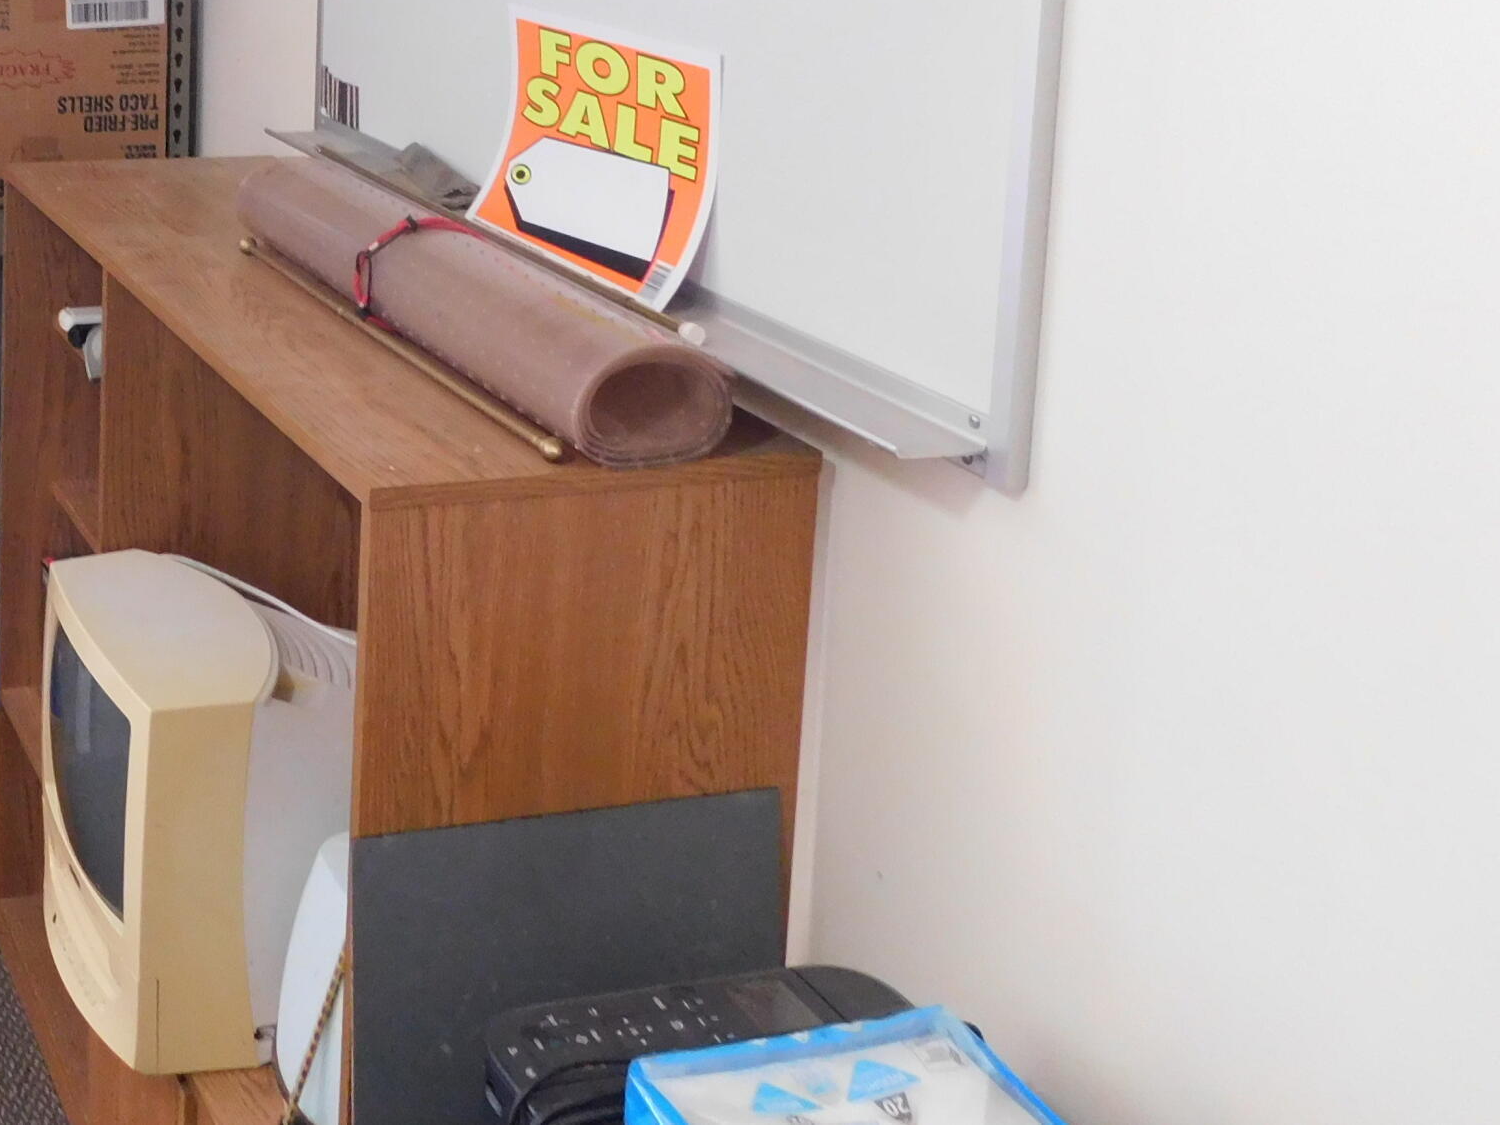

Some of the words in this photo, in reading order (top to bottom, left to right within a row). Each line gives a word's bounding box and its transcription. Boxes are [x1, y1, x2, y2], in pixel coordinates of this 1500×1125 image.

[538, 26, 690, 121] FOR
[57, 95, 114, 114] SHELLS
[119, 94, 159, 112] TACO
[84, 114, 160, 133] PRE-FRIED
[522, 76, 700, 183] SALE
